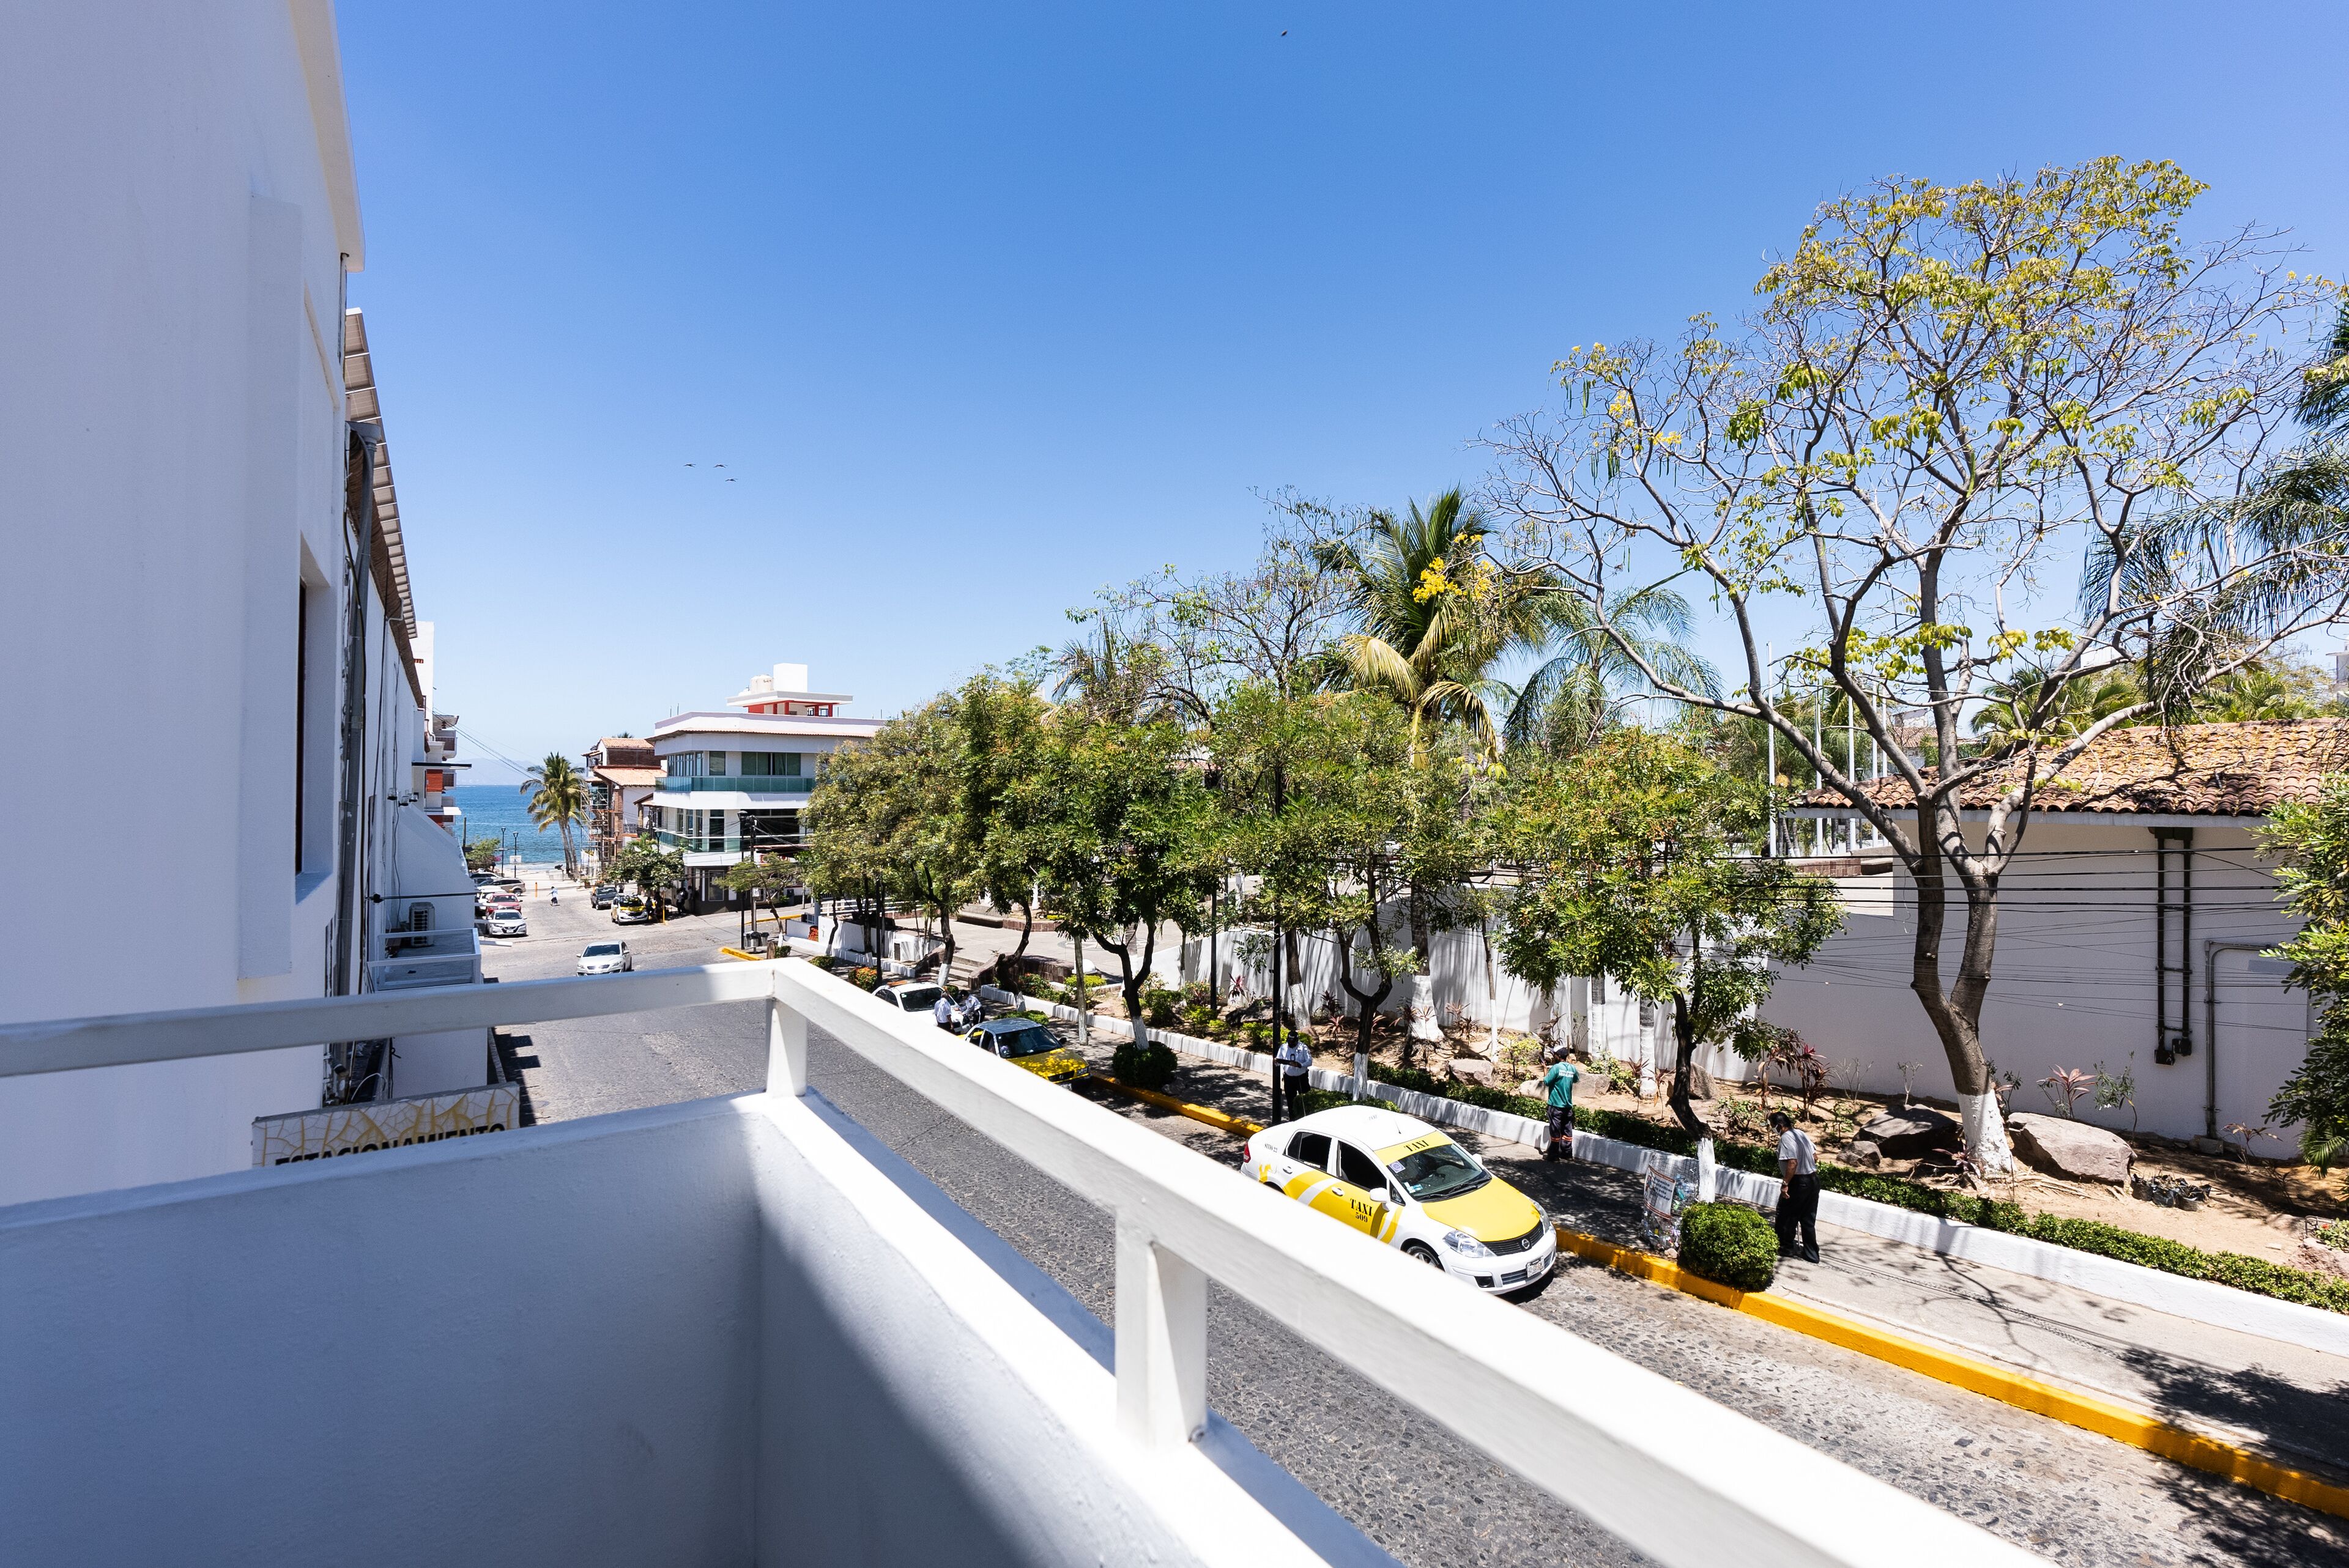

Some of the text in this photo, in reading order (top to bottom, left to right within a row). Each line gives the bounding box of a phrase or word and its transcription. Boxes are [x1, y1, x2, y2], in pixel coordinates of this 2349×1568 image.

[1404, 1140, 1429, 1152] TAXI
[1350, 1199, 1373, 1216] TAXI
[1356, 1212, 1368, 1223] 509
